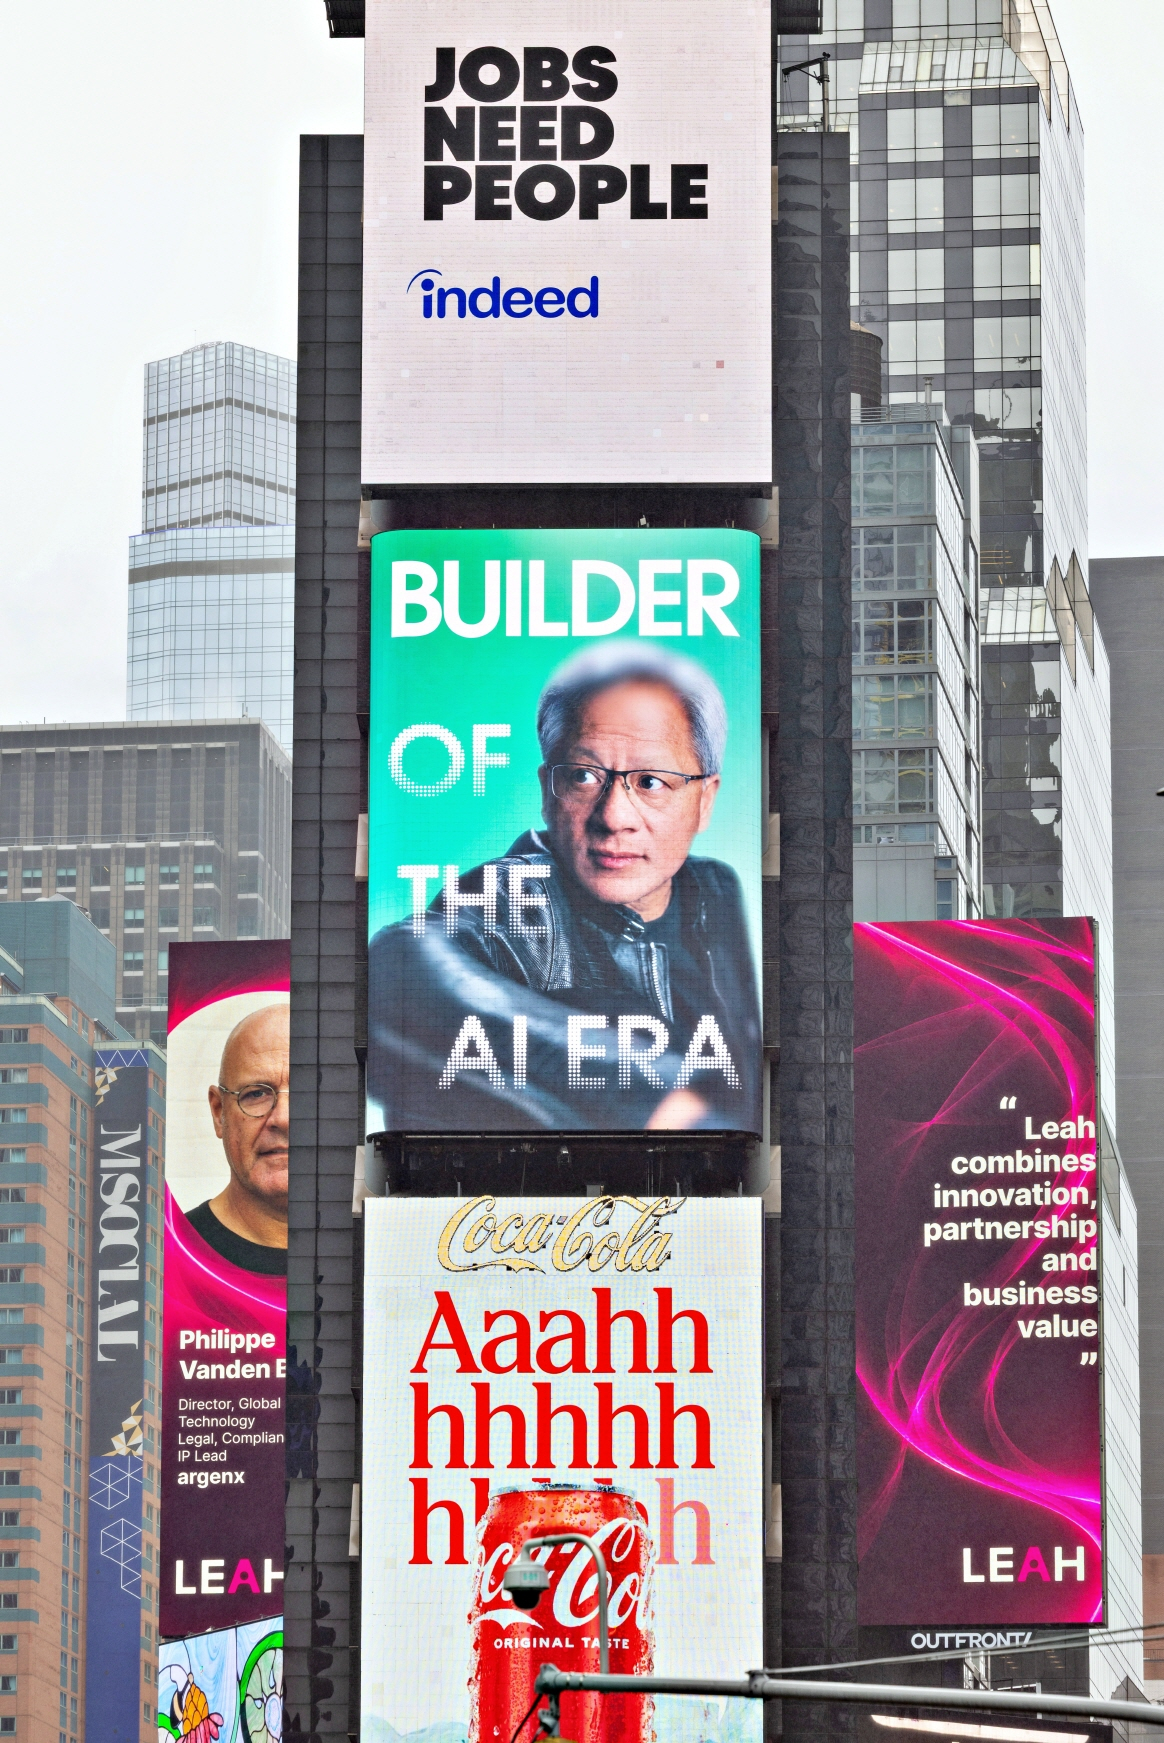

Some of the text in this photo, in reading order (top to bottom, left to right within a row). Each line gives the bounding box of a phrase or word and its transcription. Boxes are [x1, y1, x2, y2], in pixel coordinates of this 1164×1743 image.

[425, 46, 618, 102] JOBS
[424, 106, 614, 161] NEED
[424, 164, 708, 221] PEOPLE
[418, 272, 599, 319] indeed
[392, 560, 739, 638] BUILDER
[388, 722, 512, 798] OF
[397, 865, 552, 938] THE
[438, 1014, 742, 1090] AI ERA
[1026, 1116, 1095, 1139] Leah
[952, 1148, 1096, 1174] combines
[935, 1181, 1096, 1209] innovation,
[437, 1195, 687, 1275] Coca-Cola
[924, 1213, 1096, 1247] partnership
[1042, 1248, 1096, 1271] and
[964, 1281, 1097, 1306] business
[410, 1287, 714, 1374] Aaahh
[1018, 1314, 1097, 1338] value
[180, 1329, 275, 1353] Philippe
[180, 1360, 270, 1379] Vanden
[179, 1398, 280, 1411] Director, Global
[179, 1416, 255, 1429] Technology
[409, 1382, 715, 1469] hhhhh
[179, 1433, 217, 1447] Legal,
[178, 1450, 226, 1462] IP Lead
[178, 1472, 244, 1488] argenx
[962, 1546, 1085, 1583] LEAH
[494, 1638, 575, 1649] ORIGINAL
